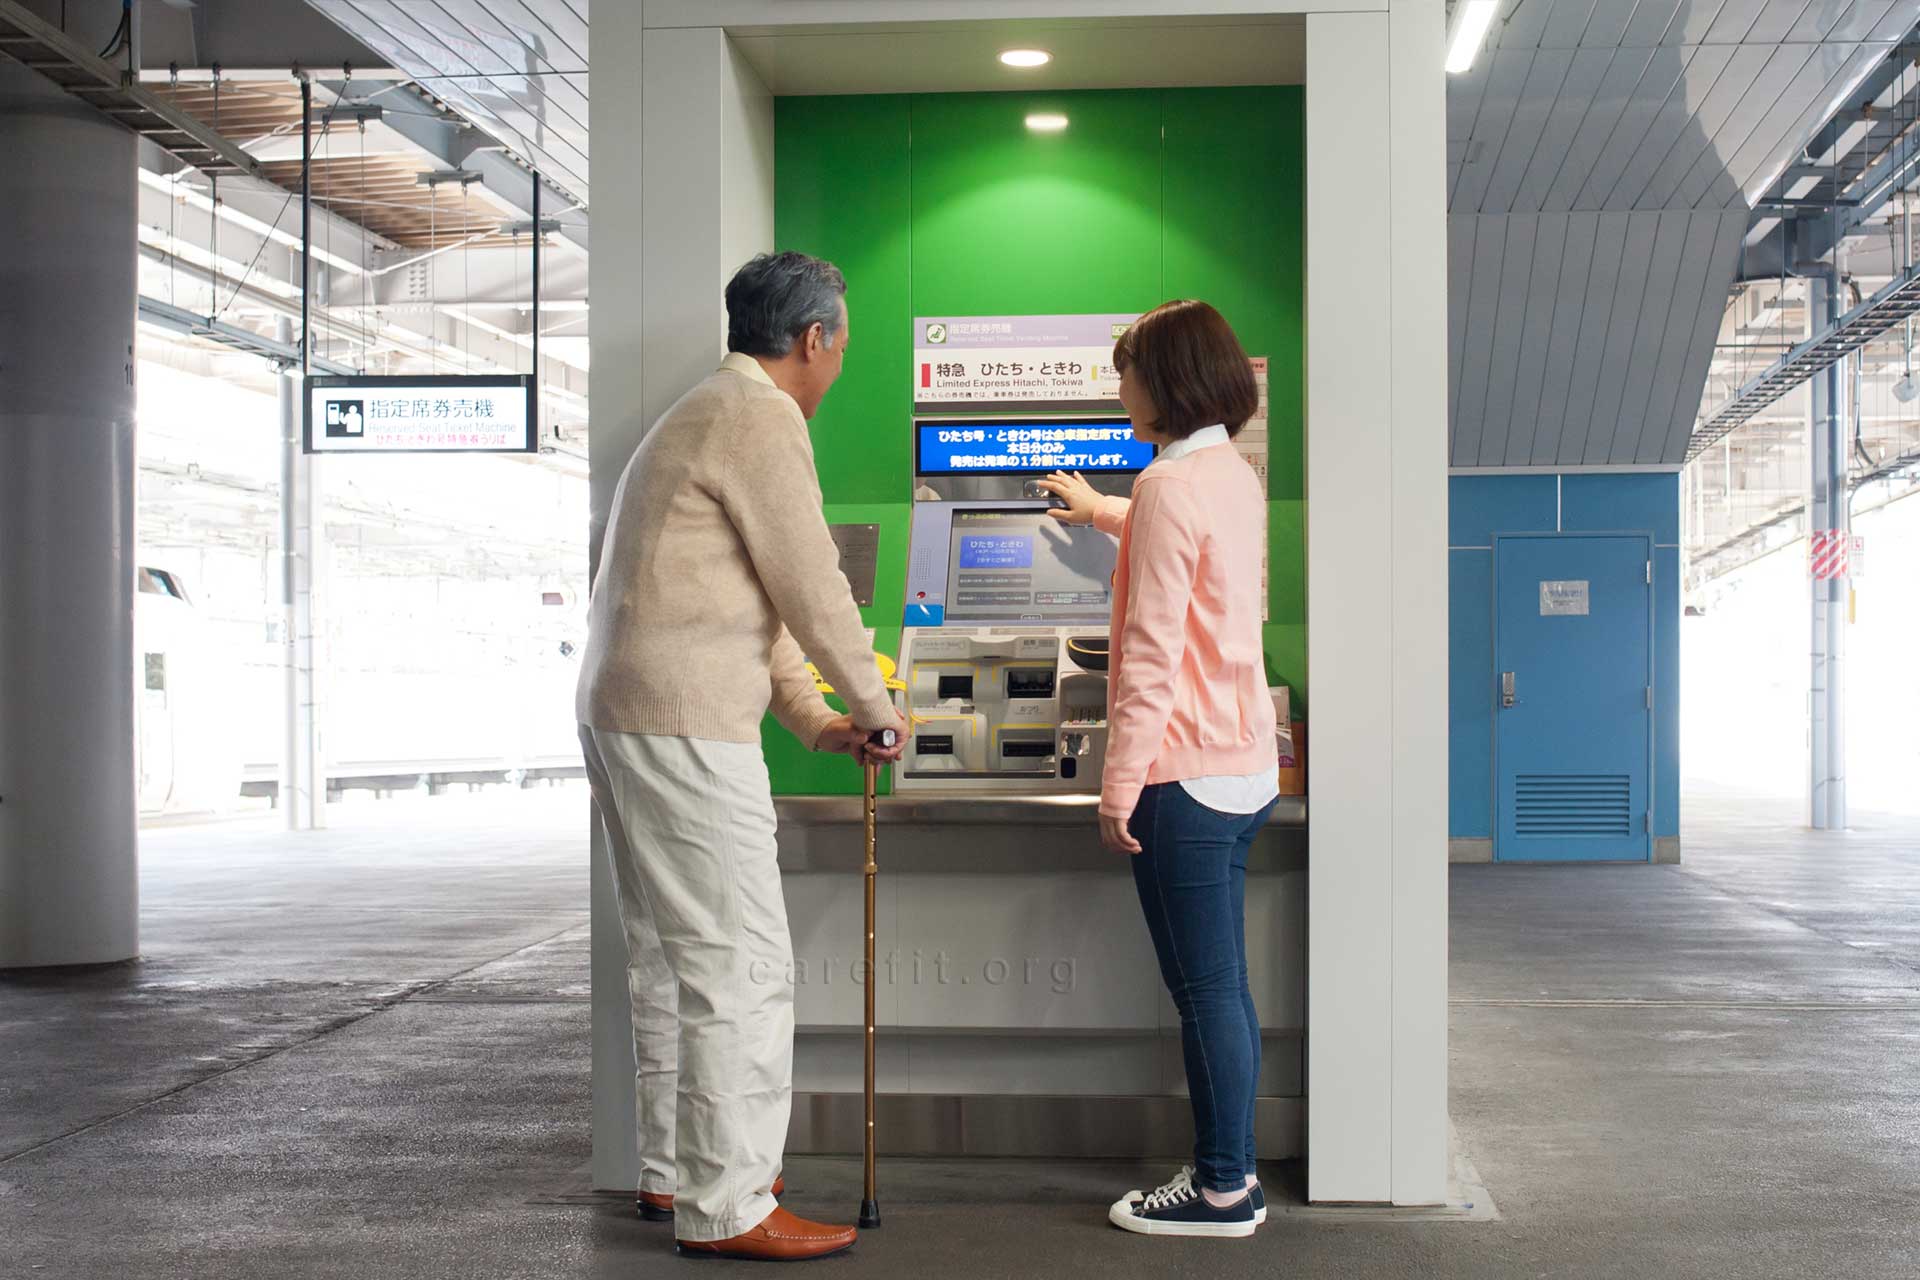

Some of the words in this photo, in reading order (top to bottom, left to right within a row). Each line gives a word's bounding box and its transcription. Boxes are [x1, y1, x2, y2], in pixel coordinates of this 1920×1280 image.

[950, 322, 1012, 335] 指定席券売機
[936, 363, 966, 377] 特急
[980, 361, 1083, 376] ひたち・ときわ
[936, 380, 971, 388] Limited
[973, 379, 1011, 389] Express
[1013, 378, 1048, 388] Hitachi,
[1051, 378, 1084, 387] Tokiwa
[369, 398, 495, 418] 指定席券売機
[475, 422, 518, 434] Machine
[1007, 442, 1066, 454] 本日分のみ
